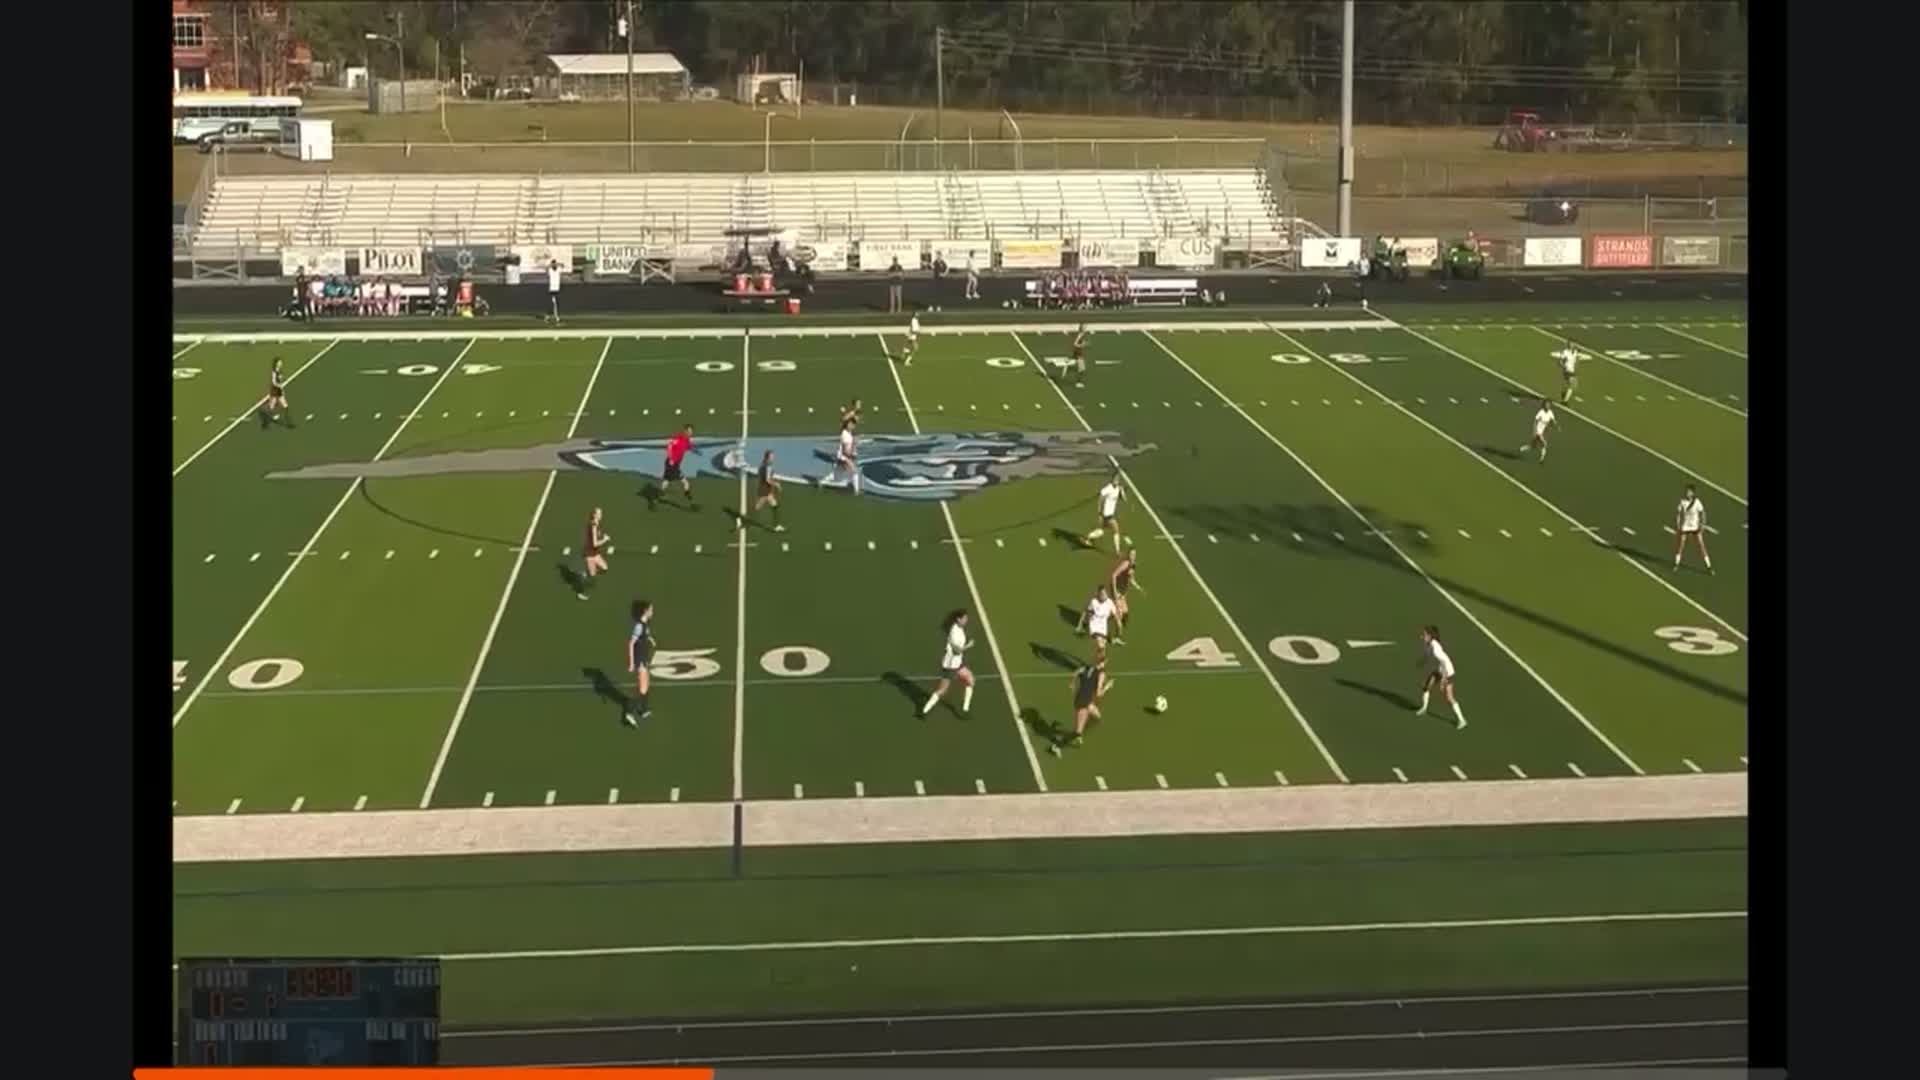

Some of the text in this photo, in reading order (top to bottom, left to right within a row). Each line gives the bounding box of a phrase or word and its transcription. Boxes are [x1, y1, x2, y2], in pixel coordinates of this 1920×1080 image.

[602, 246, 647, 257] UNITED
[1156, 238, 1212, 256] FCUS
[1596, 239, 1649, 252] STRANDS
[364, 248, 414, 269] PILOT
[602, 257, 632, 271] BANK
